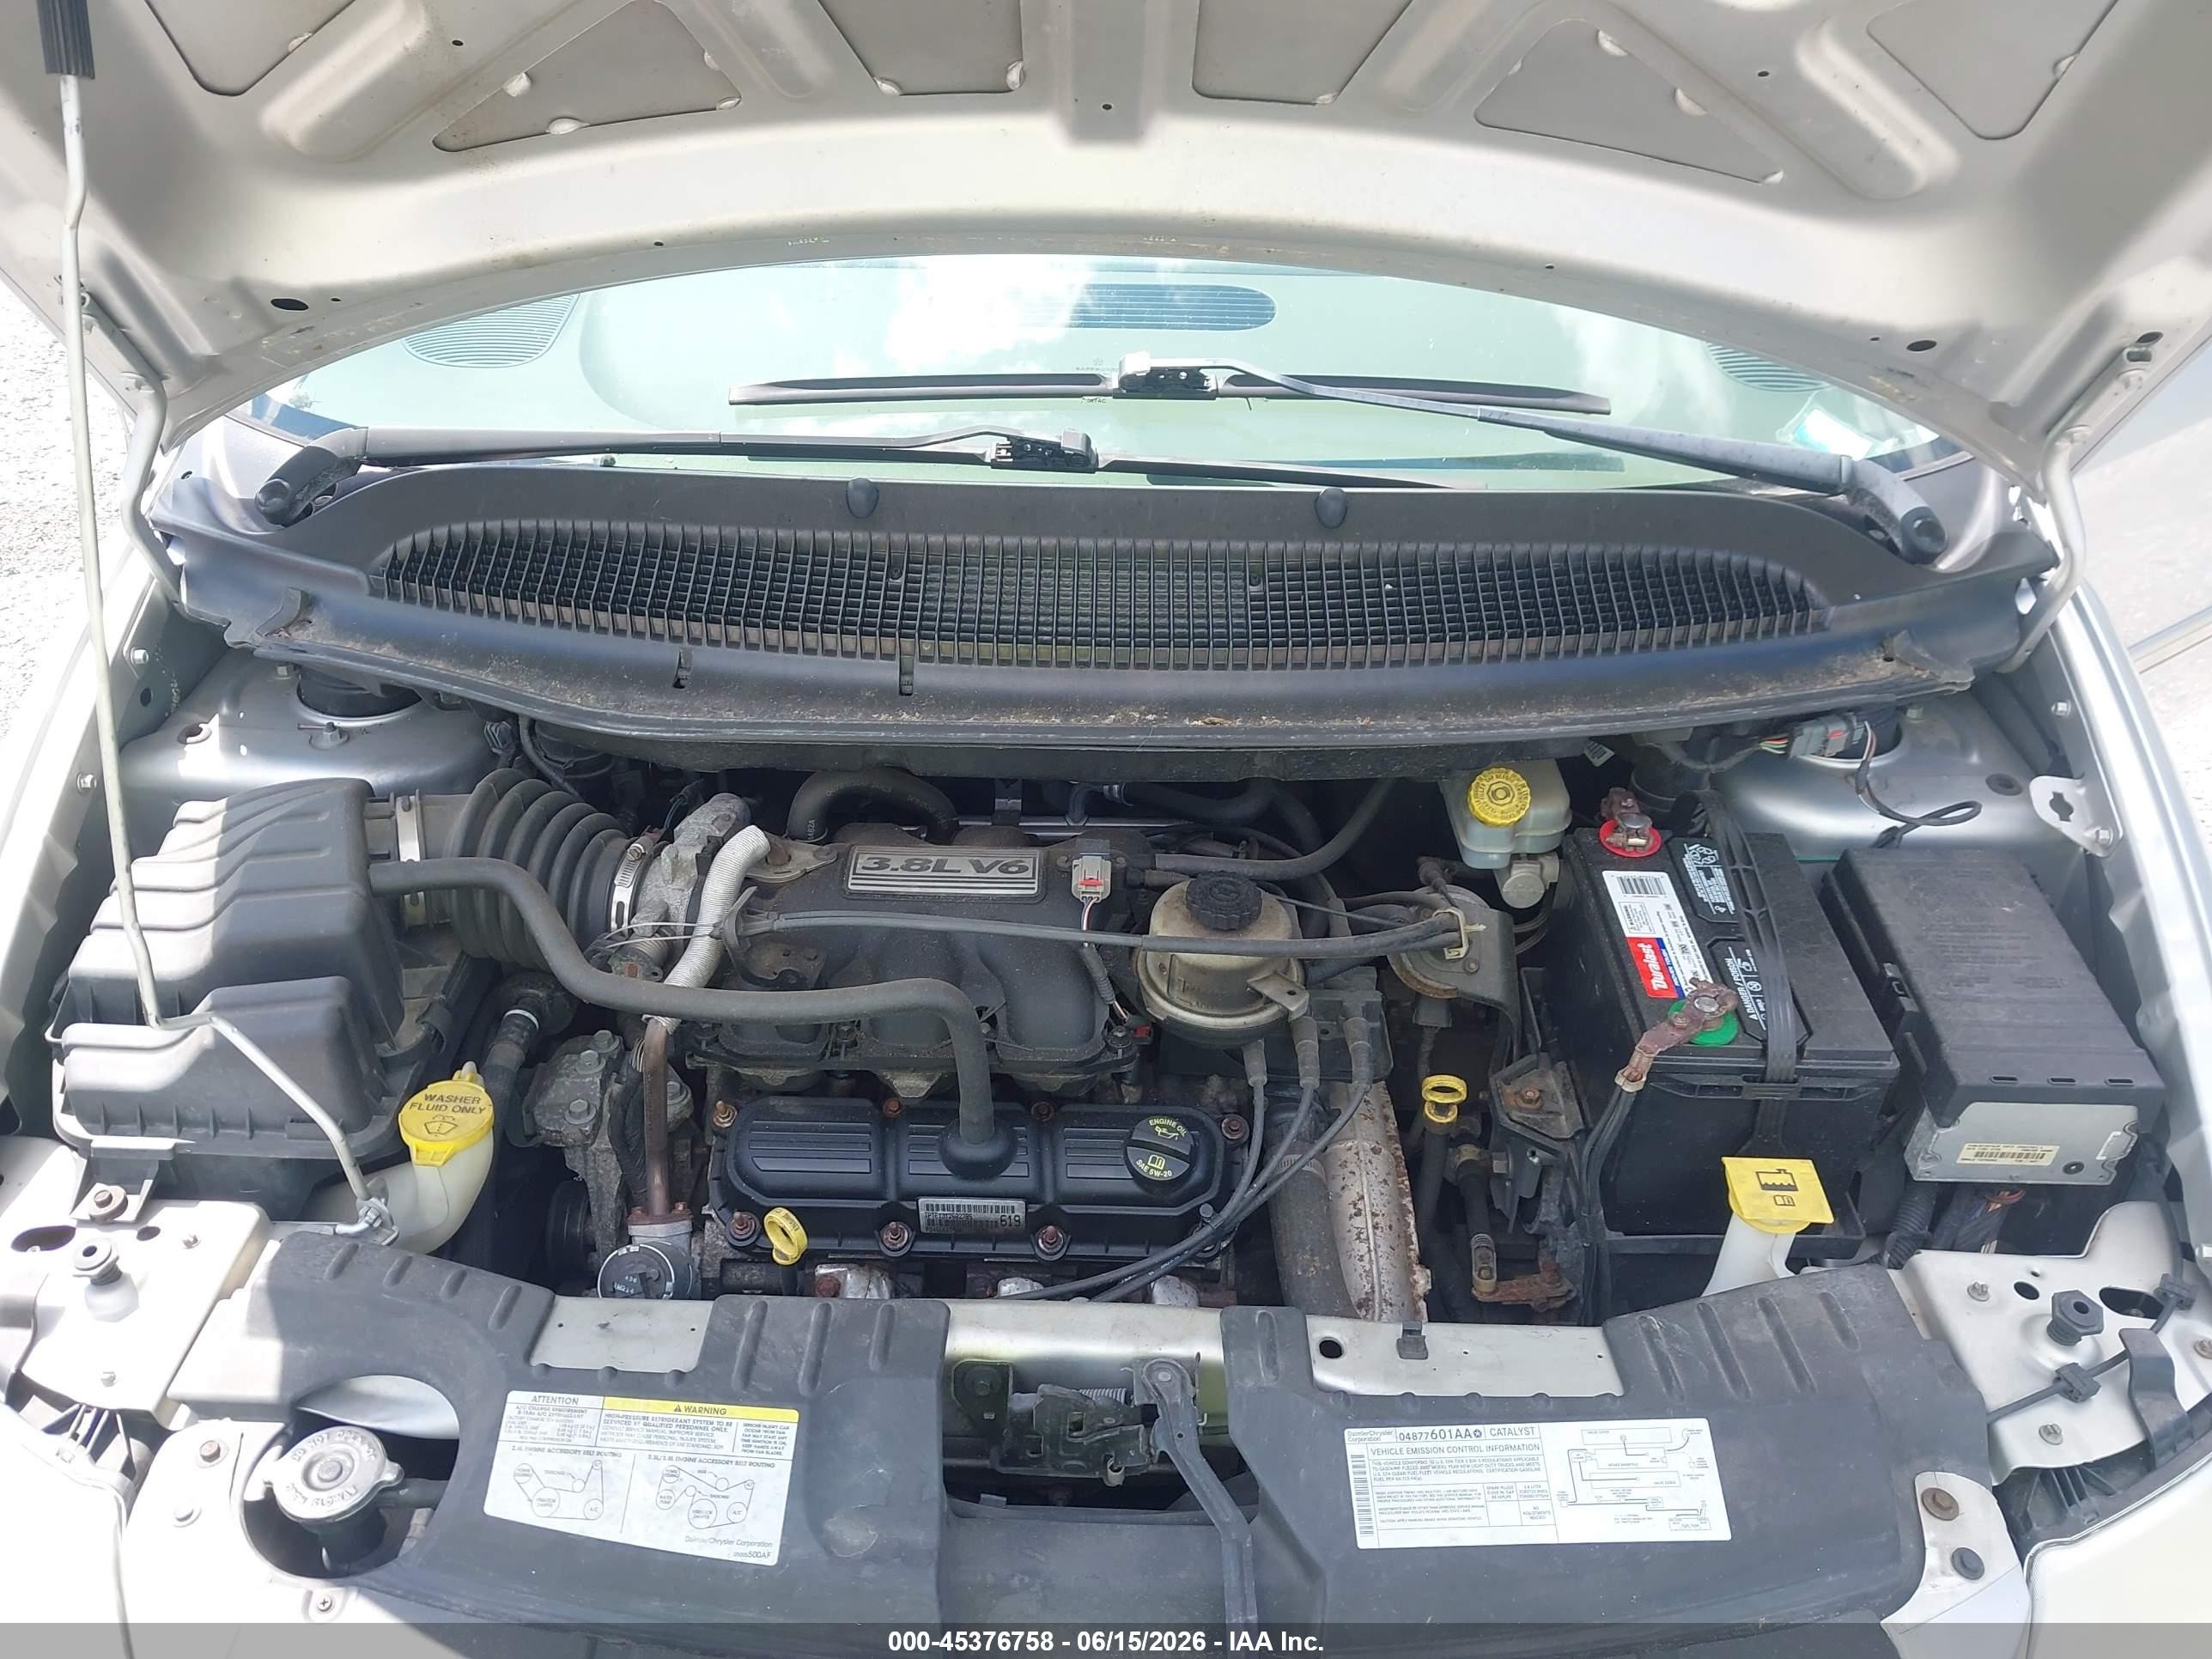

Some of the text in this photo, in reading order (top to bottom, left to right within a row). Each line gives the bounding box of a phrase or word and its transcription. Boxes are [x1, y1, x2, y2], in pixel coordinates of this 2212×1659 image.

[861, 857, 1030, 874] 3.8L V6
[1637, 943, 1668, 991] Duralast
[424, 1093, 481, 1104] WASHER
[410, 1102, 486, 1115] FLUID ONLY
[1149, 1118, 1187, 1137] ENGINE OIL
[1136, 1159, 1148, 1173] SAE
[1000, 1215, 1021, 1227] 619
[532, 1395, 580, 1406] ATTENTION
[684, 1406, 727, 1416] WARNING
[1399, 1429, 1473, 1441] 04877601AA
[1490, 1427, 1535, 1437] CATALYST
[1407, 1446, 1444, 1455] EMISSION
[1447, 1445, 1484, 1454] CONTROL
[1486, 1443, 1540, 1453] INFORMATION
[291, 1449, 307, 1462] DO
[736, 1540, 773, 1548] Corporation
